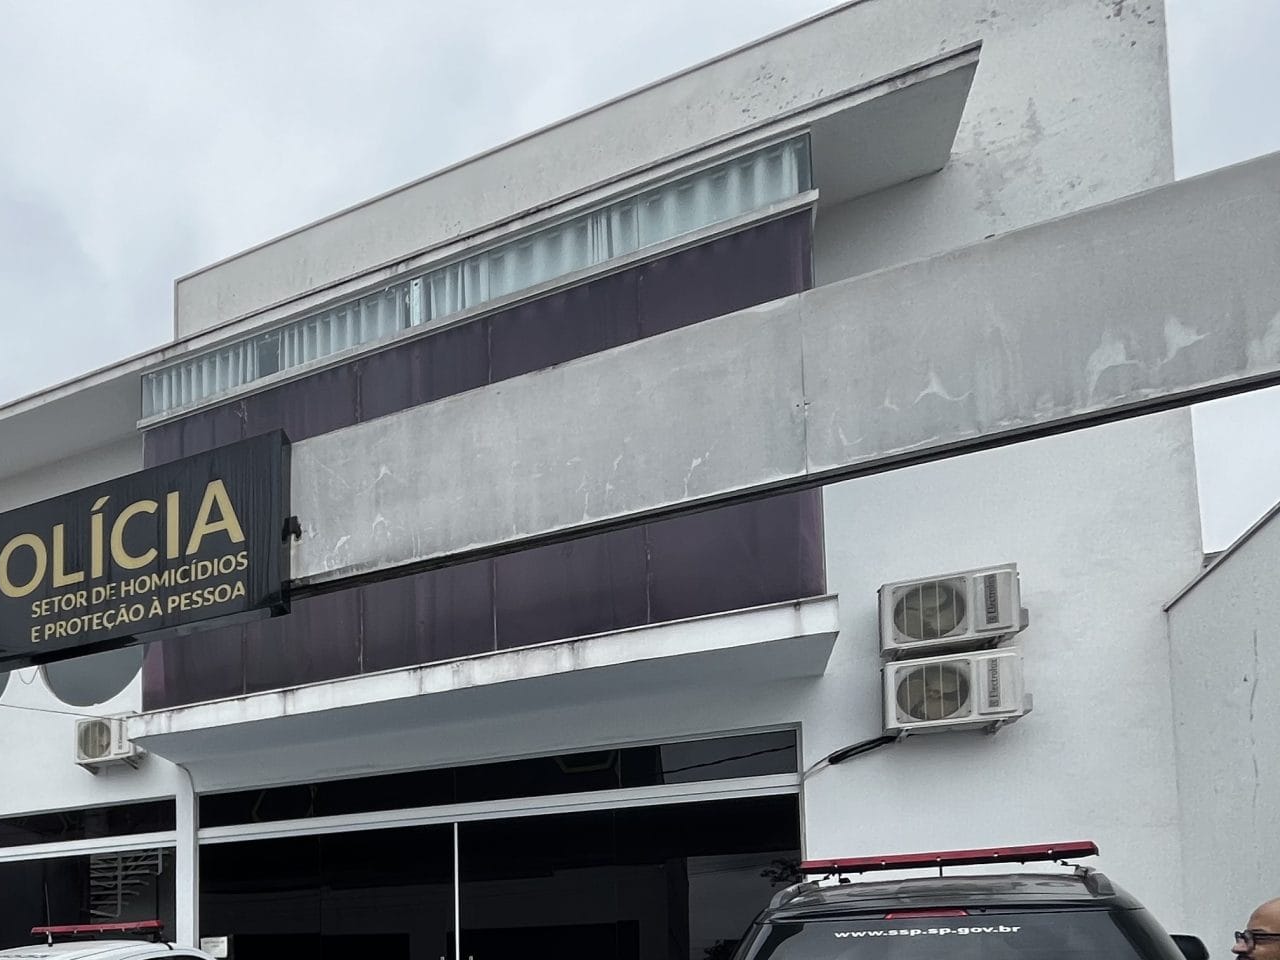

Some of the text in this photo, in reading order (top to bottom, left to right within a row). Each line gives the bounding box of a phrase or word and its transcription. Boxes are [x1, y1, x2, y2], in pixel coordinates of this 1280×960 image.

[31, 551, 249, 618] SETOR DE HOMICÍDIOS
[31, 581, 246, 644] E PROTEÇÃO À PESSOA
[834, 925, 1021, 938] www.ssp.sp.gov.br
